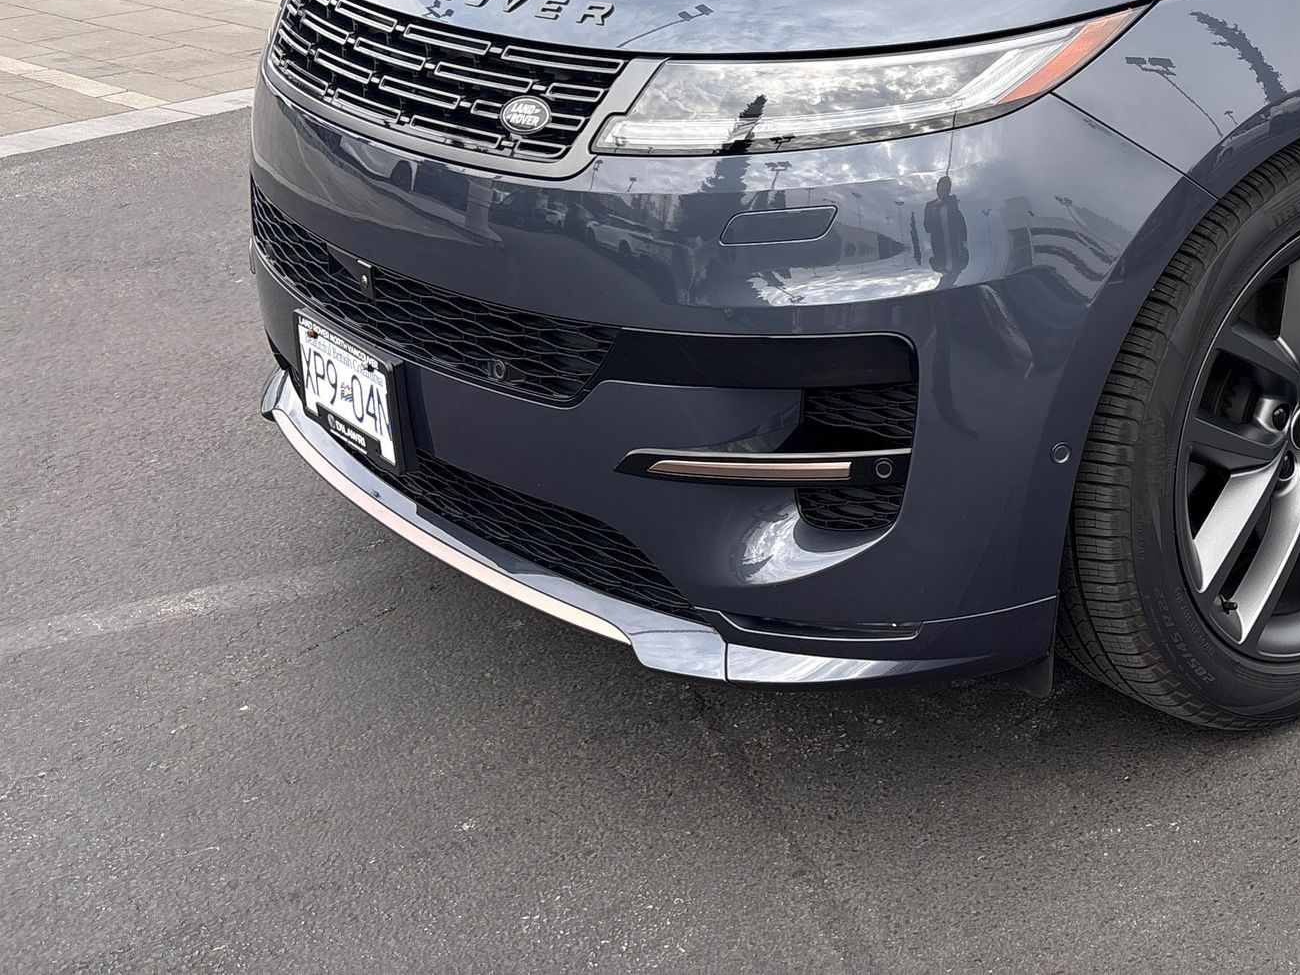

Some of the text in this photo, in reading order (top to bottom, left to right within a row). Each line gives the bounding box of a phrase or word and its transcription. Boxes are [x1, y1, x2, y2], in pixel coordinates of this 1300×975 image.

[511, 103, 536, 115] LAND
[509, 113, 540, 127] ROVER
[301, 344, 338, 405] XP9
